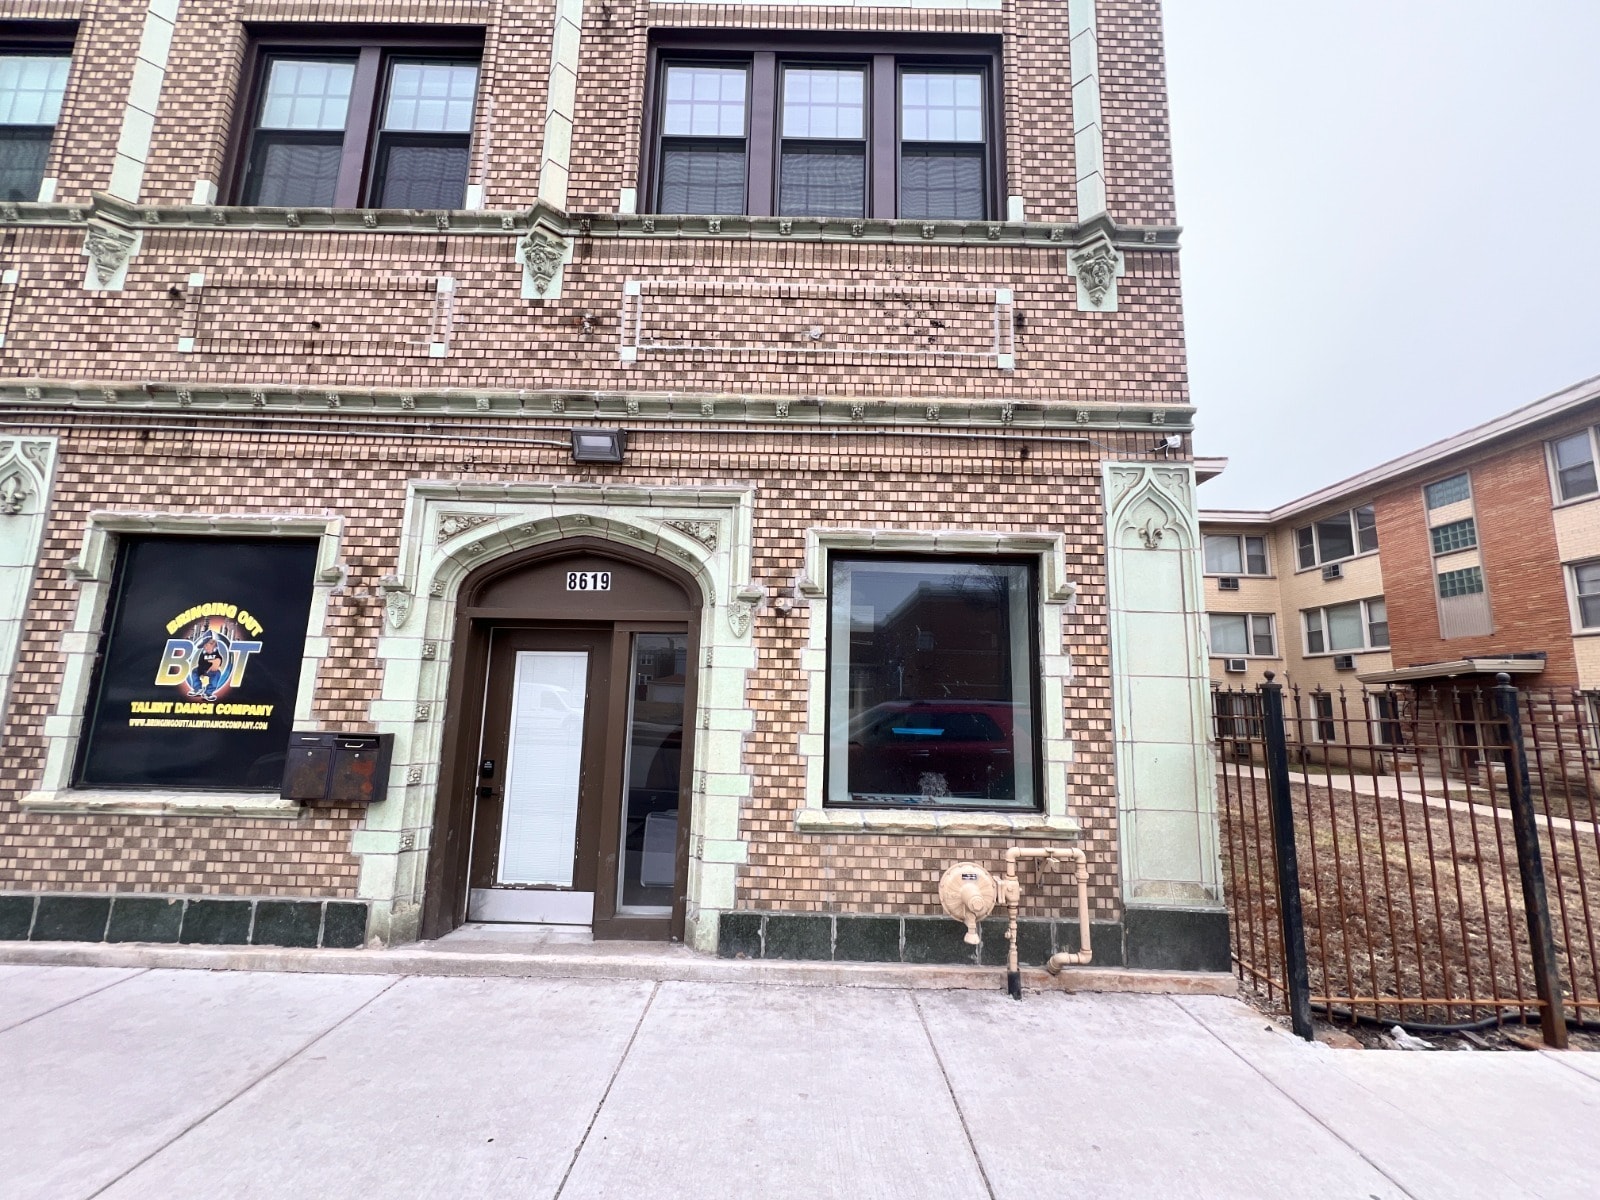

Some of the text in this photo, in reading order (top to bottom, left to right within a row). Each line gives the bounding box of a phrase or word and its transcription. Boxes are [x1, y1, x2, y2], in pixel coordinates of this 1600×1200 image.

[568, 572, 610, 590] 8619
[166, 603, 263, 637] BRINGING OUT
[155, 639, 262, 690] BOT
[131, 701, 273, 716] TALENT DANCE COMPANY
